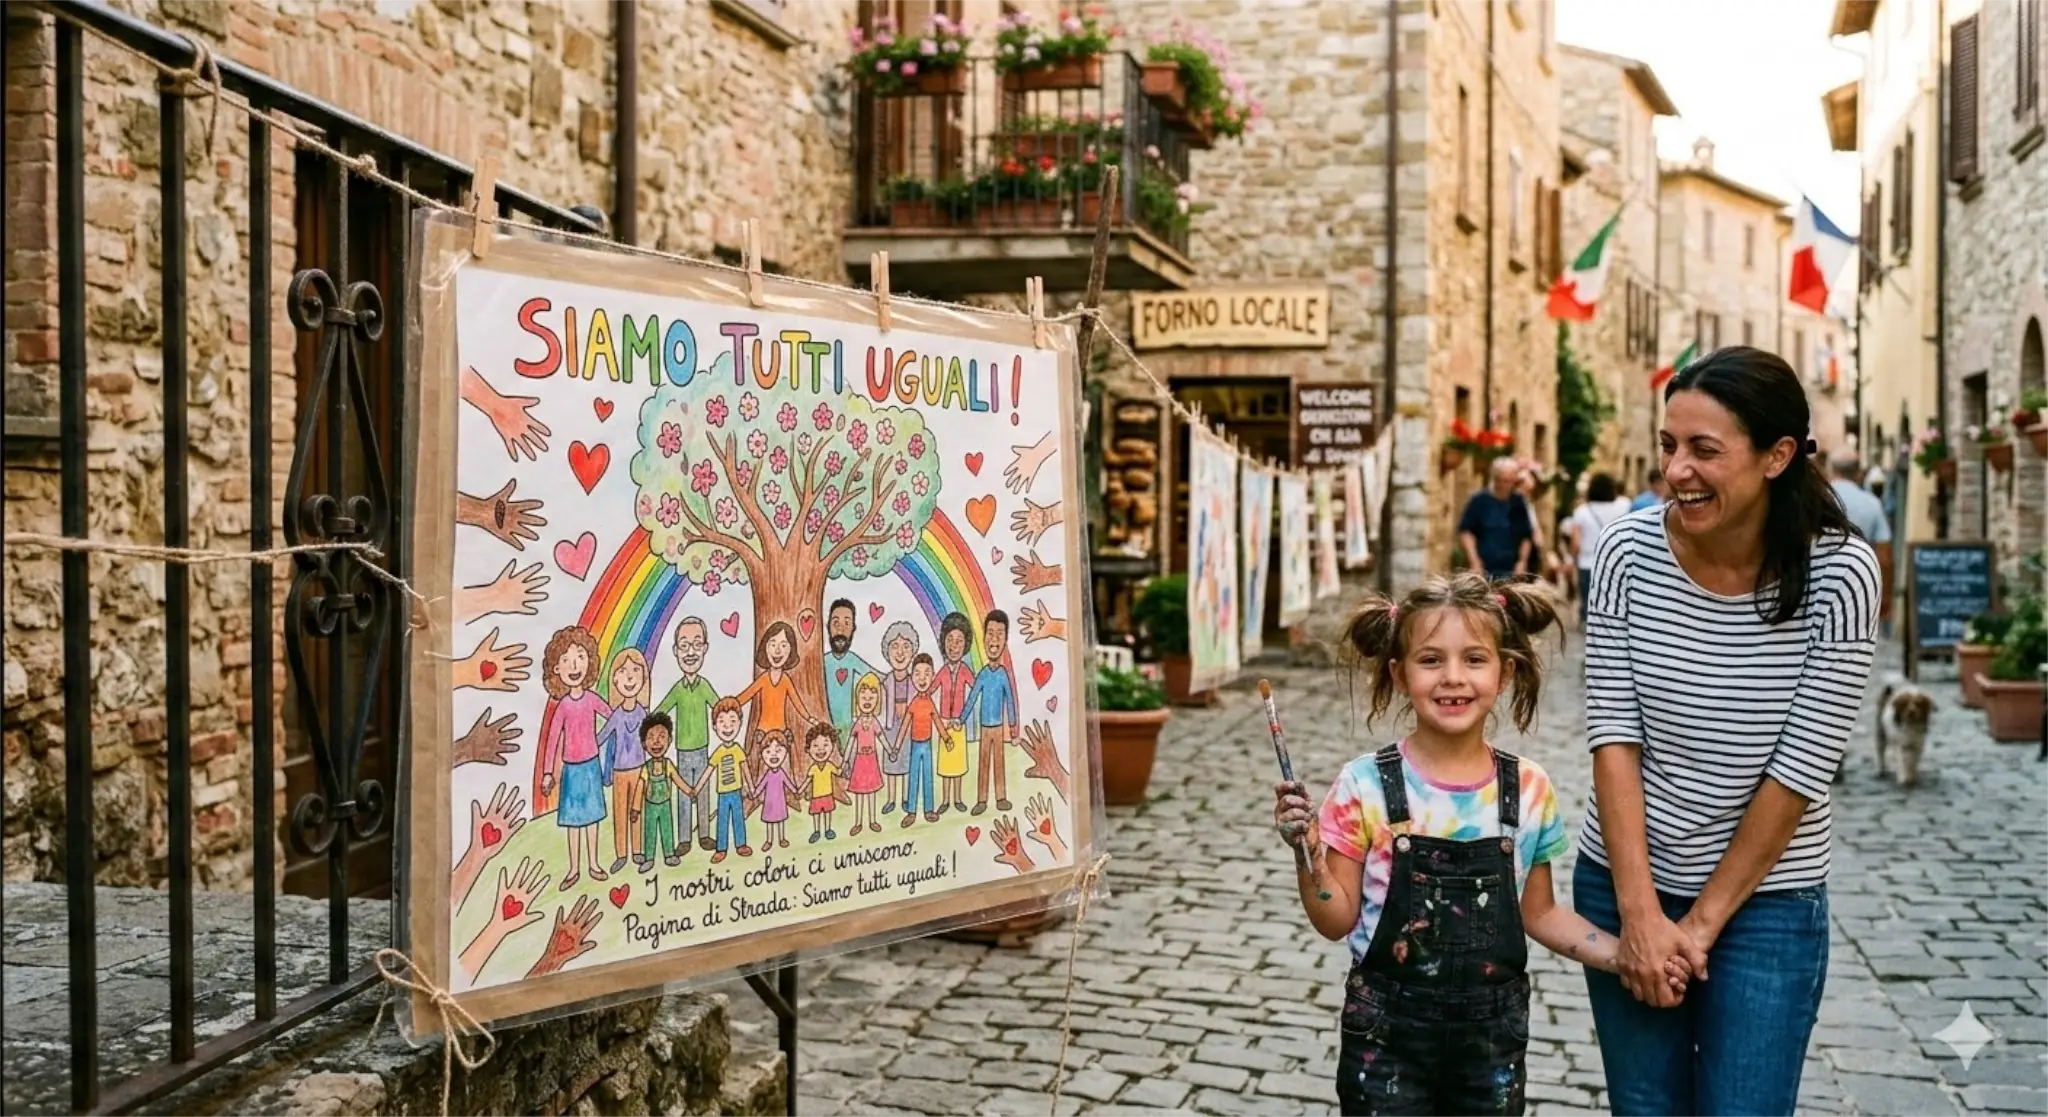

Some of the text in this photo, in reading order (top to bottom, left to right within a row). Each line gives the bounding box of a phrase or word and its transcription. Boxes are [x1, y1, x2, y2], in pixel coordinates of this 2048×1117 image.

[514, 297, 697, 386] SIAMO
[720, 323, 843, 394] TUTTI
[1142, 298, 1318, 338] FORNO LOCALE
[668, 869, 734, 901] nostri
[743, 857, 800, 888] colori
[808, 860, 826, 875] ci
[834, 840, 918, 868] uniscono.
[622, 912, 695, 950] Pagina
[702, 900, 721, 926] di
[729, 895, 798, 923] Strada:
[802, 881, 853, 909] Siamo
[857, 873, 891, 895] tutti
